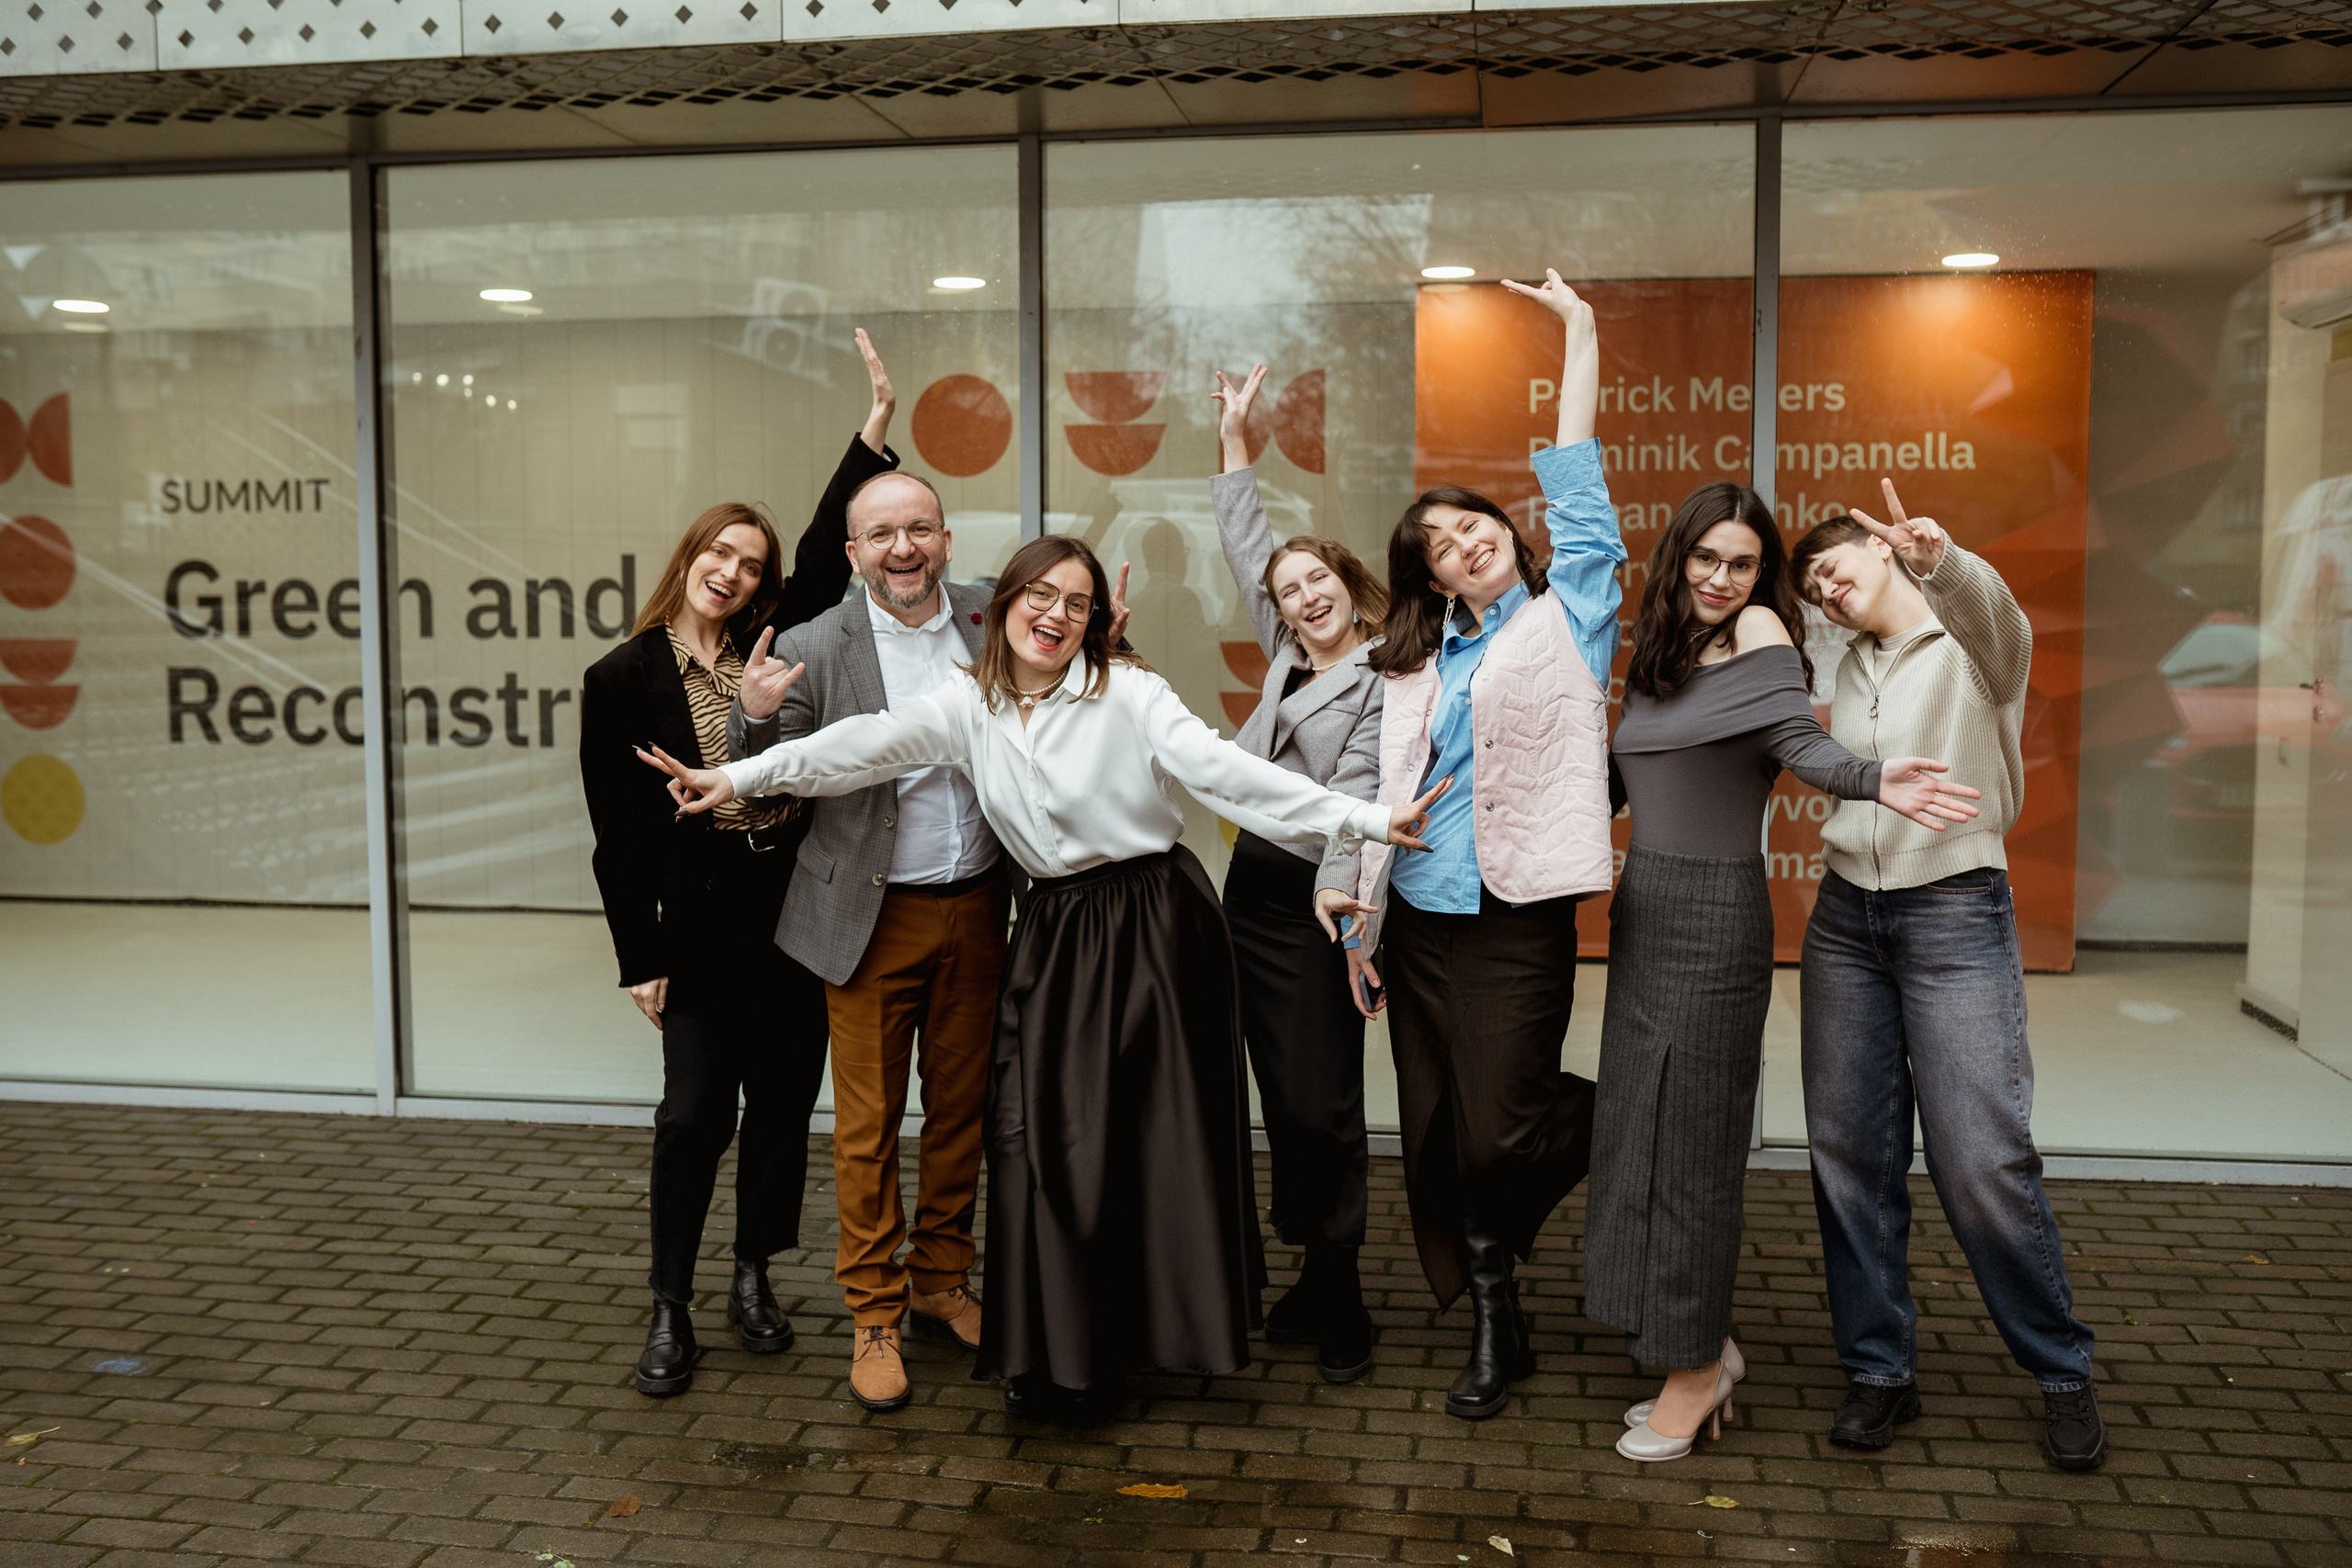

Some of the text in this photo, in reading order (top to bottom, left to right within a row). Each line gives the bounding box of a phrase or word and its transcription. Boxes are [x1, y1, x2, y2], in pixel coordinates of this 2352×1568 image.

[1529, 376, 1847, 413] Prick Meers
[1529, 431, 1976, 480] minik Cmpanella
[162, 479, 331, 514] SUMMIT
[164, 554, 636, 639] Green and
[167, 666, 584, 749] Reconstr
